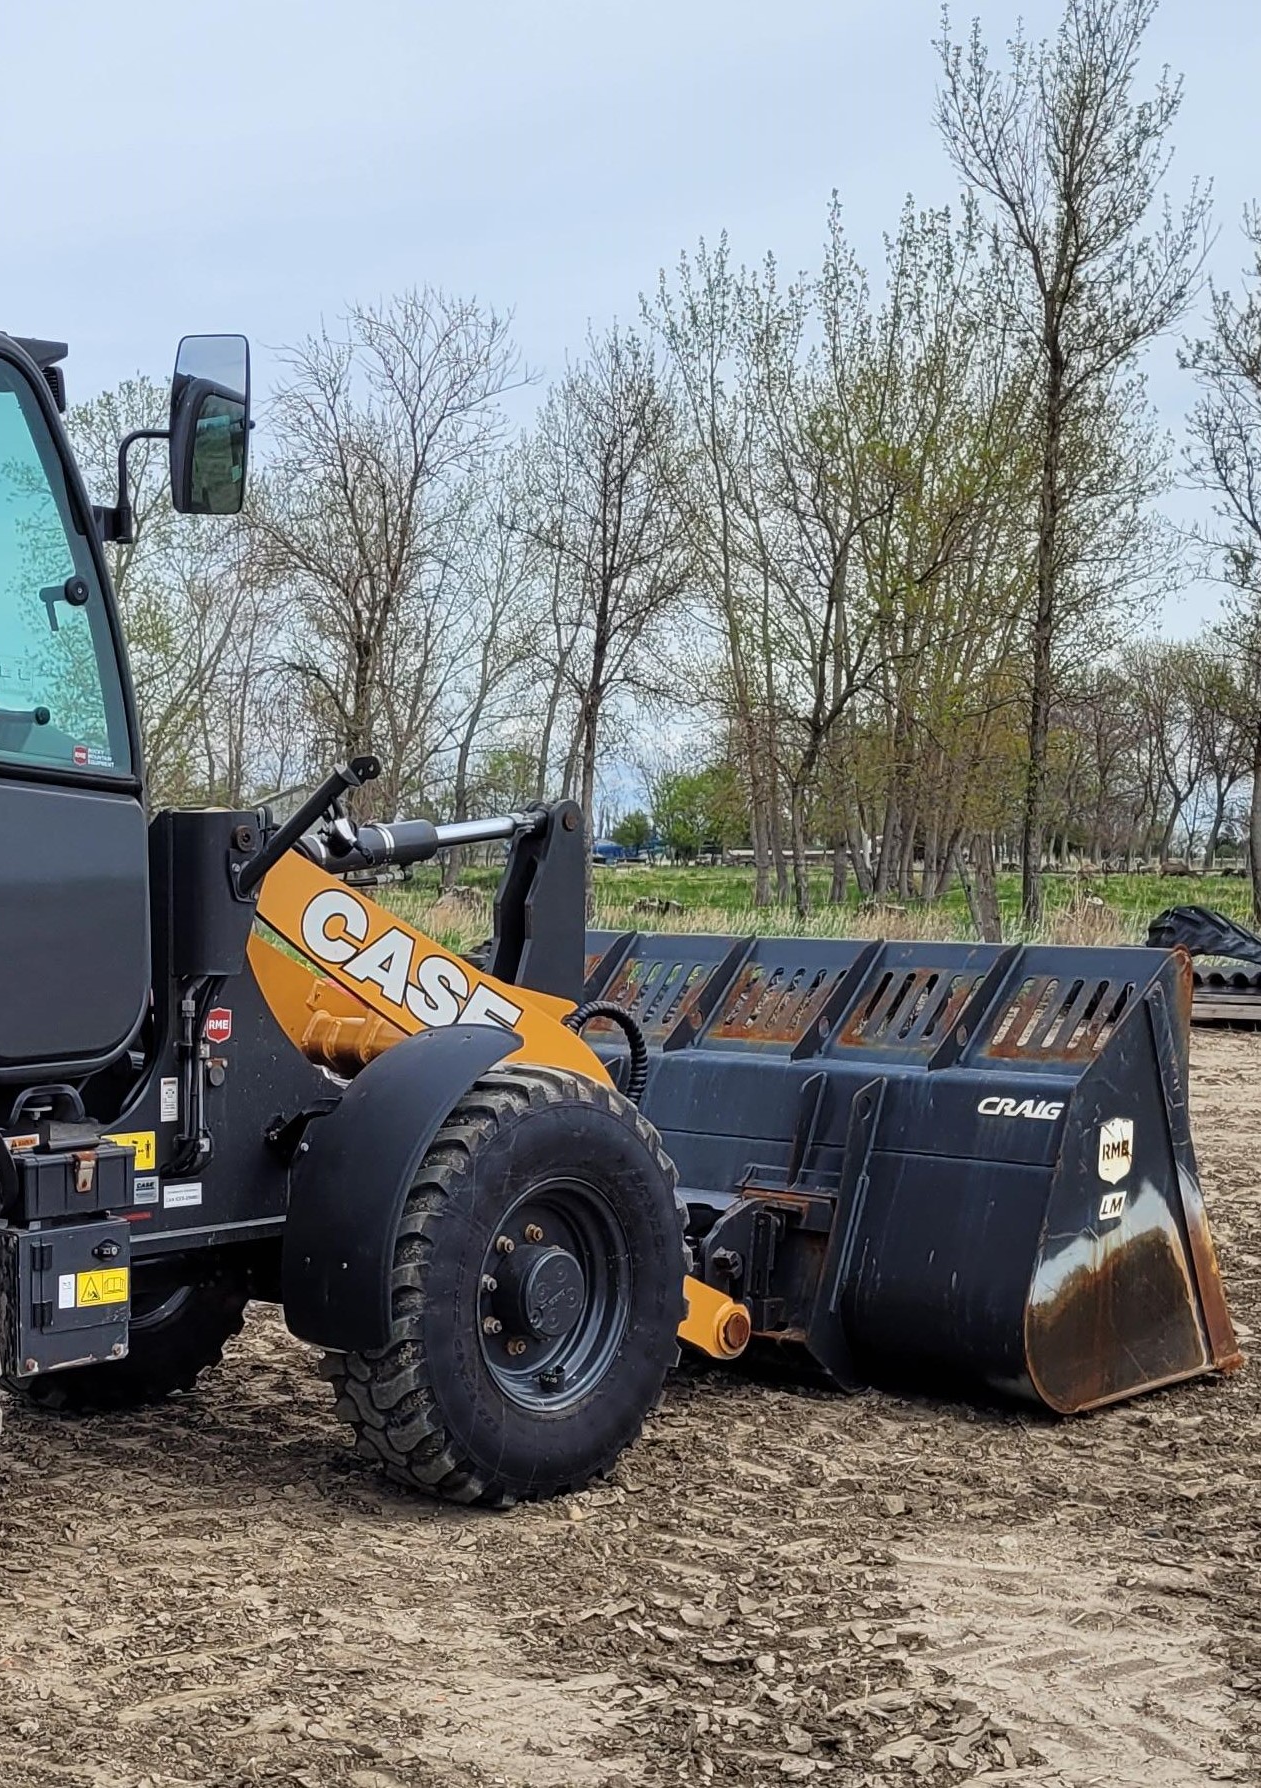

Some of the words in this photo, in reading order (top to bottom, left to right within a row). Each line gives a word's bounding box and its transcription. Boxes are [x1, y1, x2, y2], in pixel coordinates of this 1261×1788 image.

[208, 1019, 229, 1030] RME
[977, 1096, 1065, 1121] CRAIG
[1100, 1196, 1124, 1215] LM
